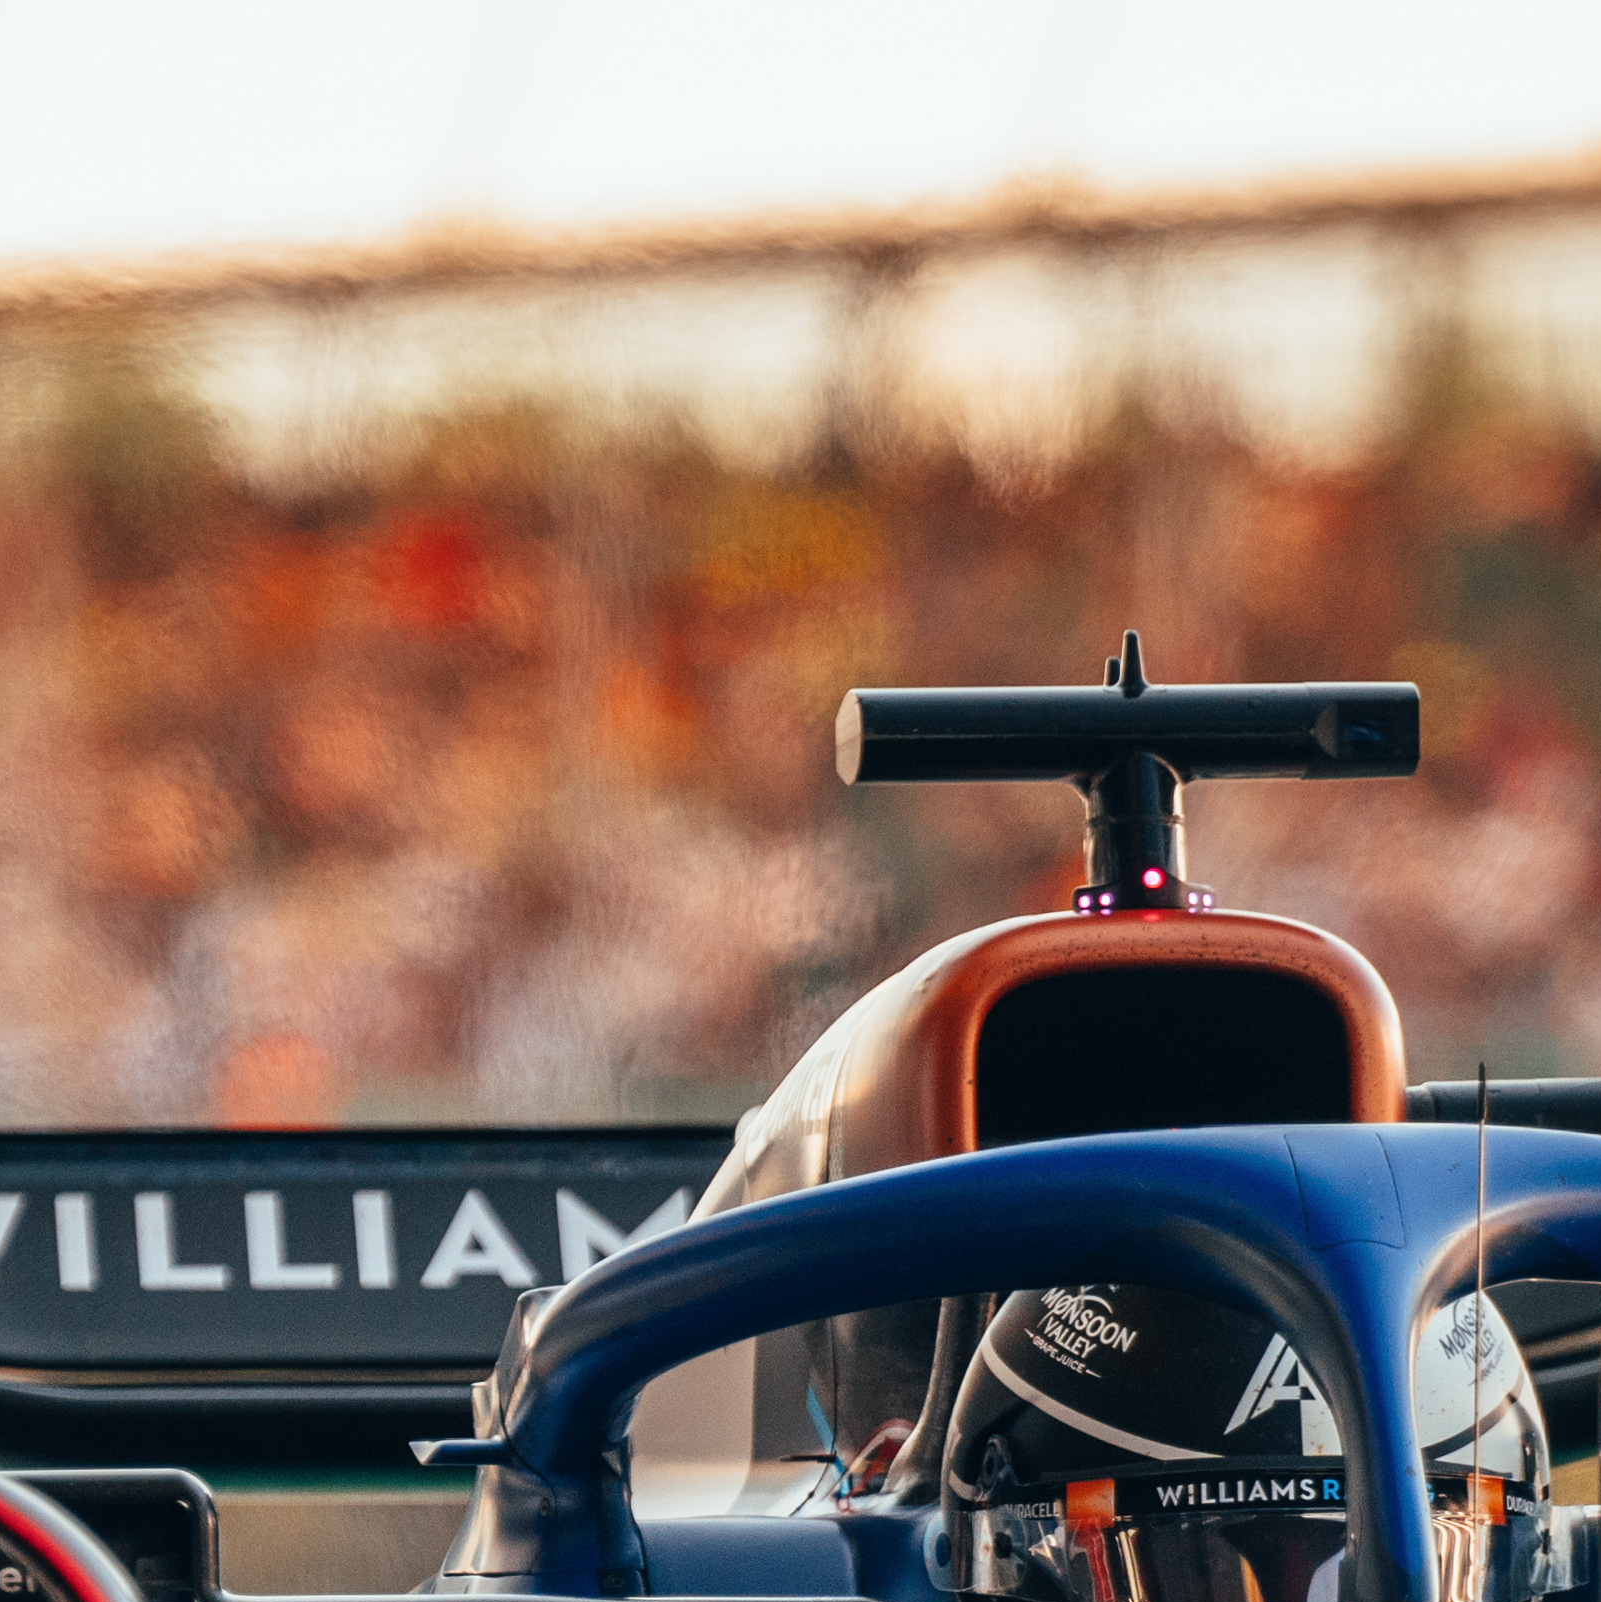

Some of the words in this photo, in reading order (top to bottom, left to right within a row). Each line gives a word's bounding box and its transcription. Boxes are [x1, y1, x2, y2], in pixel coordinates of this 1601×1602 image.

[1032, 1335, 1058, 1358] GRAPE
[1056, 1351, 1086, 1374] JUICE
[1044, 1316, 1097, 1359] VALLEY
[1156, 1478, 1316, 1507] WILLIAMS
